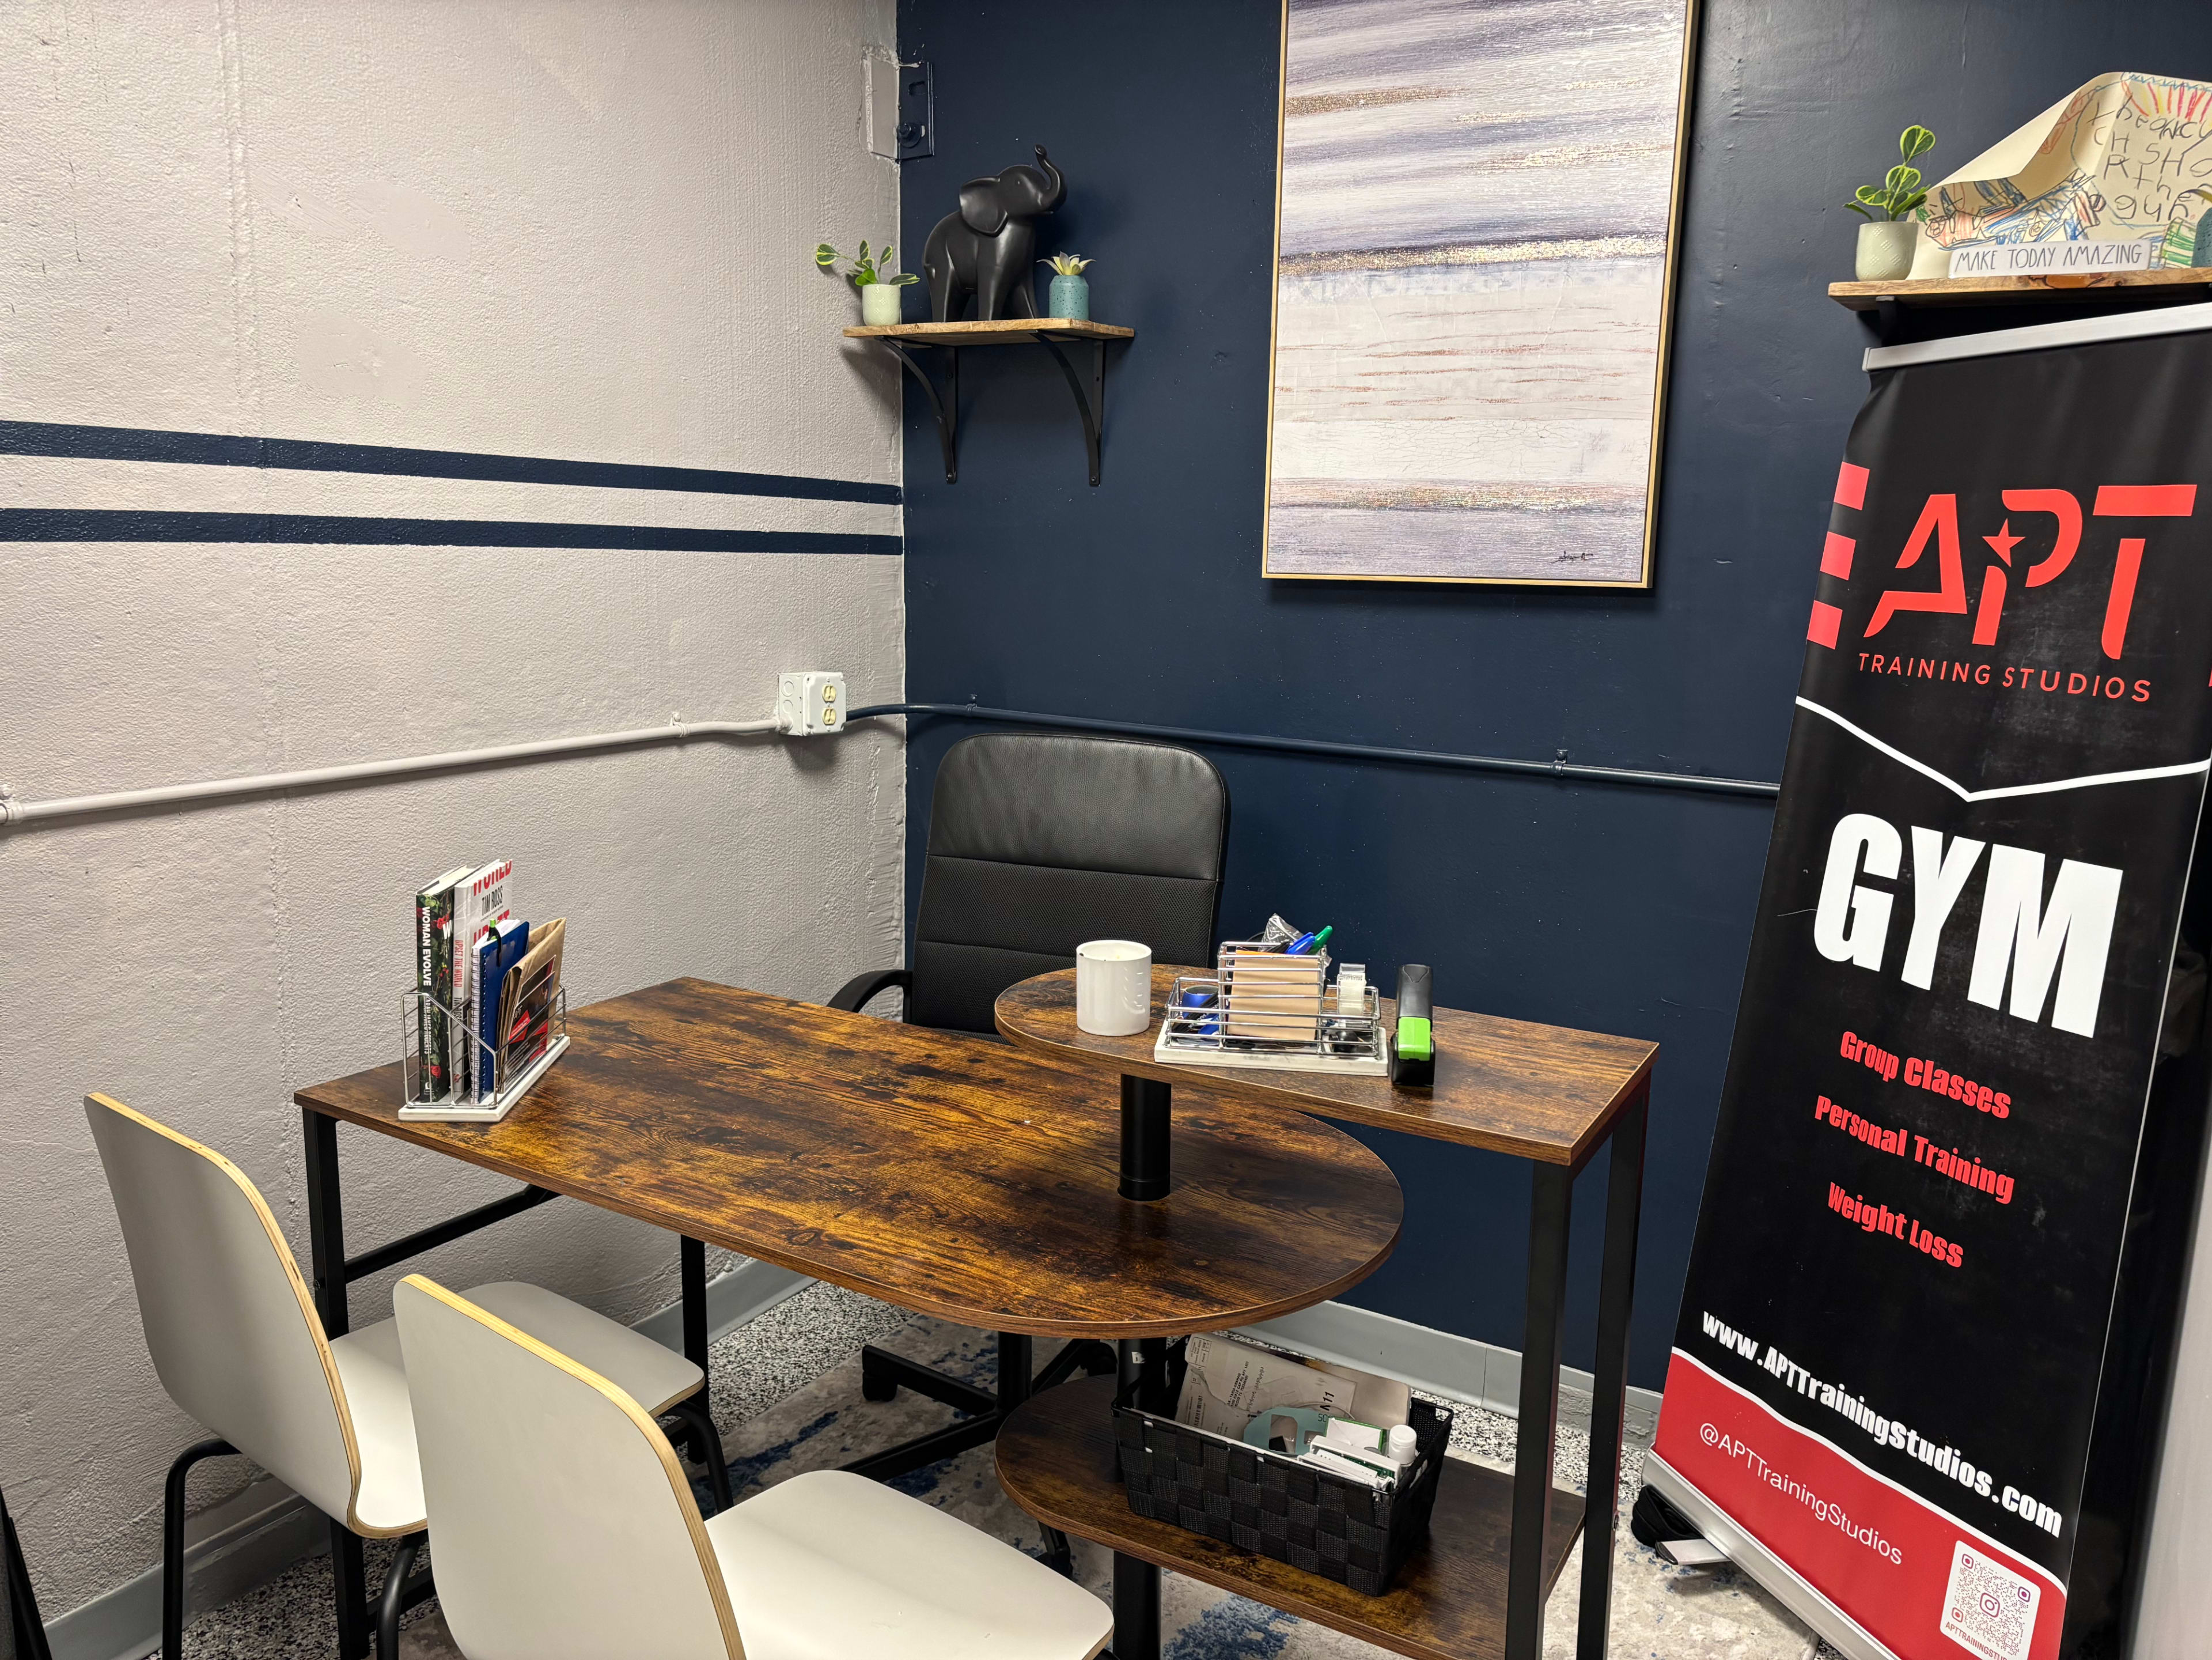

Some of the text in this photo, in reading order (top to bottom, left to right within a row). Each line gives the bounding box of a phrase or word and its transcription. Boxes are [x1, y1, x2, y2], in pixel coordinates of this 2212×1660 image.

[1955, 244, 2142, 273] MAKE TODAY AMAZING
[1863, 484, 2198, 660] APT
[1859, 653, 2151, 702] TRAINING STUDIOS
[482, 893, 490, 916] TIM
[491, 884, 503, 911] ROSS
[1815, 814, 2123, 1038] GYM
[422, 906, 431, 986] WOMAN EVOLVE
[453, 940, 464, 988] UPSET THE WORLD
[1840, 1032, 2012, 1119] Group Classes
[1815, 1095, 2015, 1204] Personal Training
[1828, 1182, 1964, 1268] Weight Loss
[1703, 1311, 2062, 1538] www.APTTrainingStudios.com
[1700, 1423, 1902, 1565] @APTTrainingStudios
